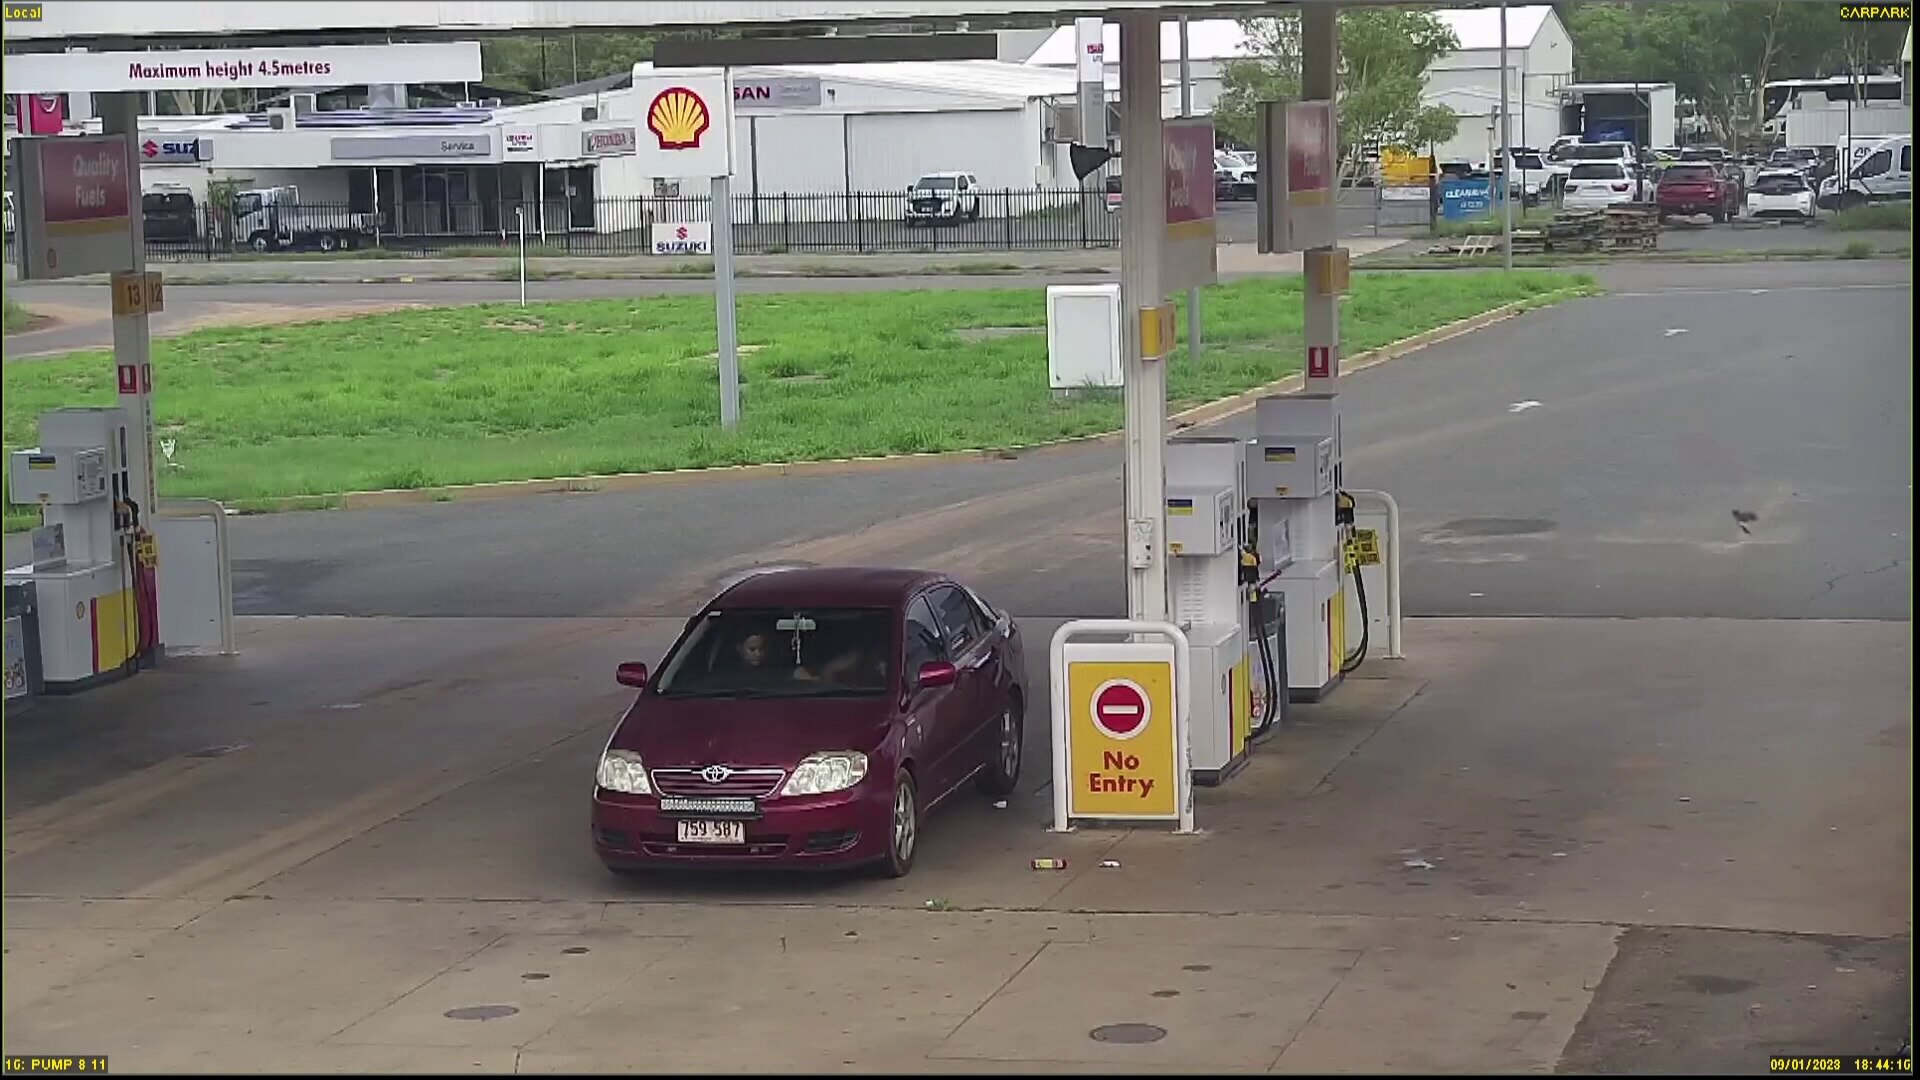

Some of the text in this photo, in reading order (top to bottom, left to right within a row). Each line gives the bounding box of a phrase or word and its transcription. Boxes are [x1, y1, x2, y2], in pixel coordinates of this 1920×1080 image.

[129, 60, 331, 80] Maximum height 4.5metres
[441, 141, 476, 152] Service
[596, 132, 627, 148] HONDA
[73, 152, 118, 181] Quality
[75, 184, 106, 207] Fuels
[656, 242, 707, 252] SUZUKI
[127, 284, 141, 306] 13
[150, 282, 163, 304] 12
[1104, 751, 1139, 771] No
[1089, 773, 1153, 798] Entry
[682, 821, 707, 838] 759
